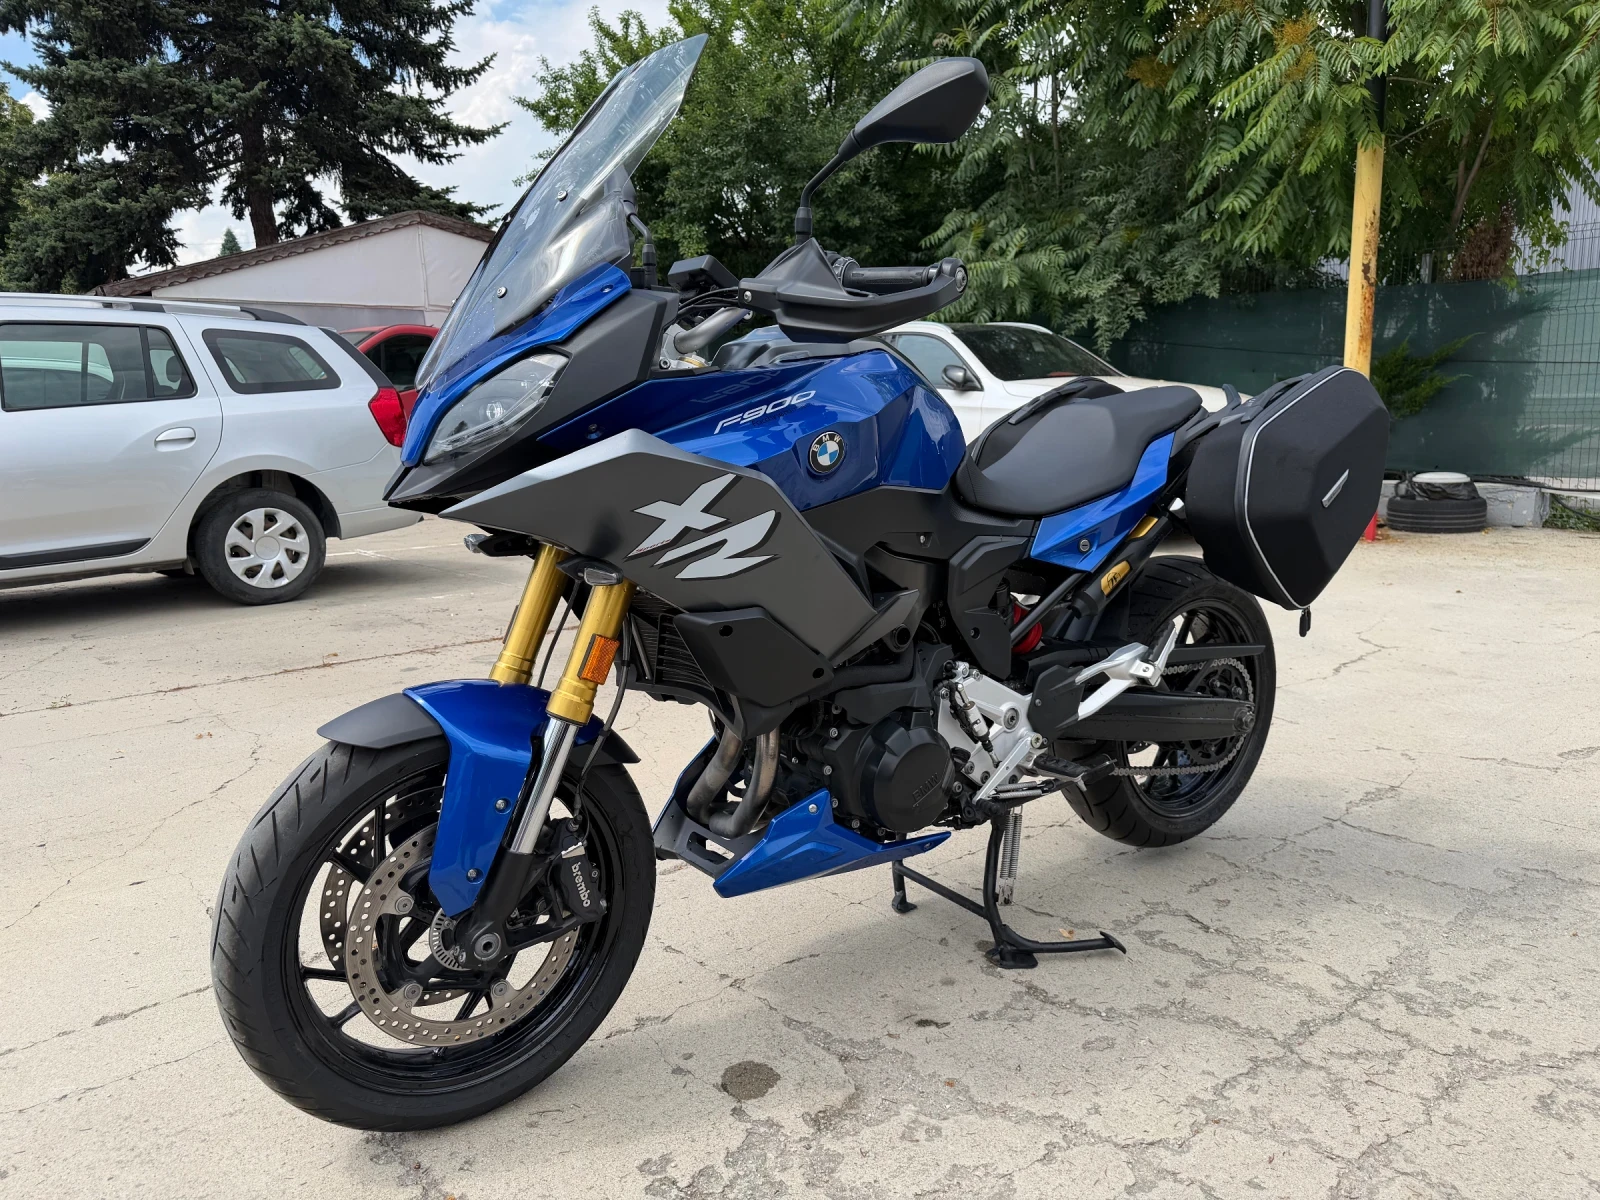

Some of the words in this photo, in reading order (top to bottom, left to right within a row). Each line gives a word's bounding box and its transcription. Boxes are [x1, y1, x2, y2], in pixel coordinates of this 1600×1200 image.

[714, 390, 816, 434] F900
[812, 434, 842, 452] BMW
[913, 772, 941, 802] BMW
[571, 861, 591, 908] brembo
